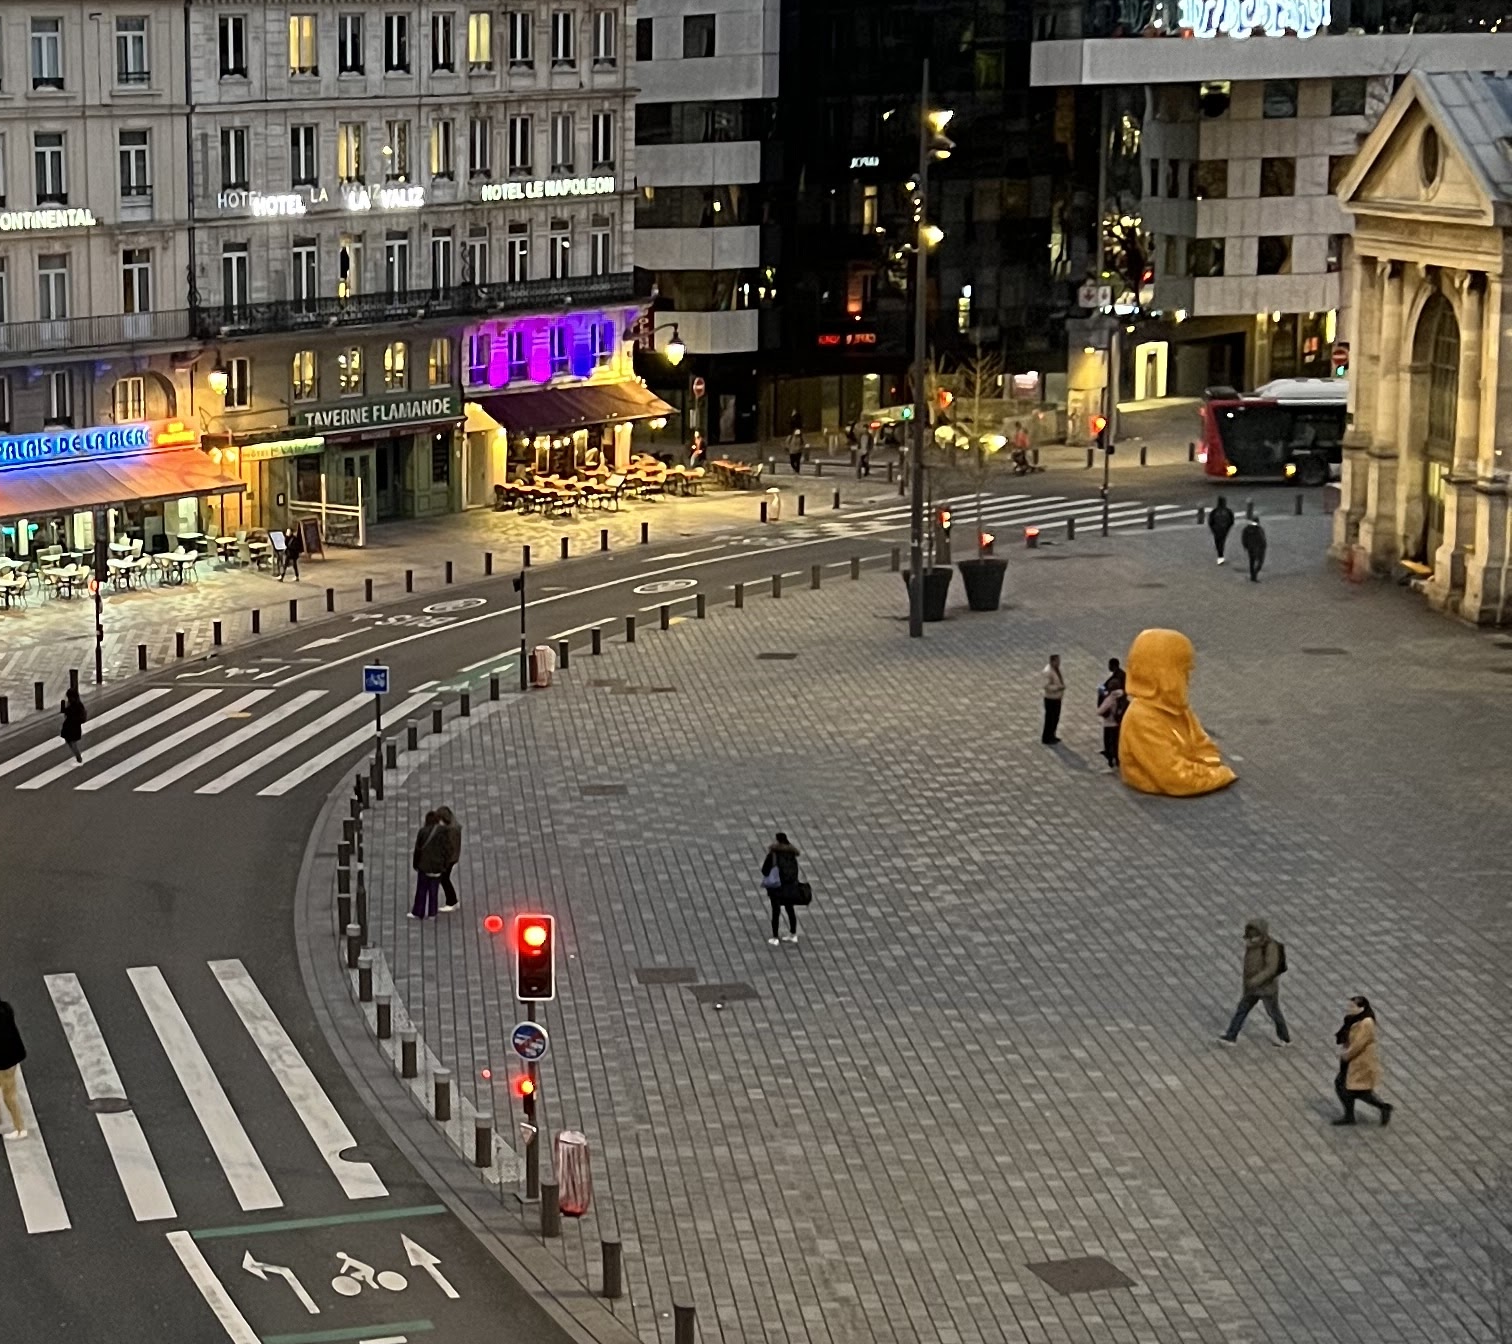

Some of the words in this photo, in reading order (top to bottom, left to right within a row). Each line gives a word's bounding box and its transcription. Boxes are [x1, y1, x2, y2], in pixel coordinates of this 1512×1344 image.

[481, 182, 525, 201] HOTEL
[526, 180, 544, 198] LE
[544, 176, 615, 197] NAPOLEON
[251, 194, 307, 216] HOTEL
[304, 406, 370, 427] TAVERNE
[372, 397, 451, 421] FLAMANDE
[56, 433, 81, 454] DE
[83, 430, 104, 450] LA
